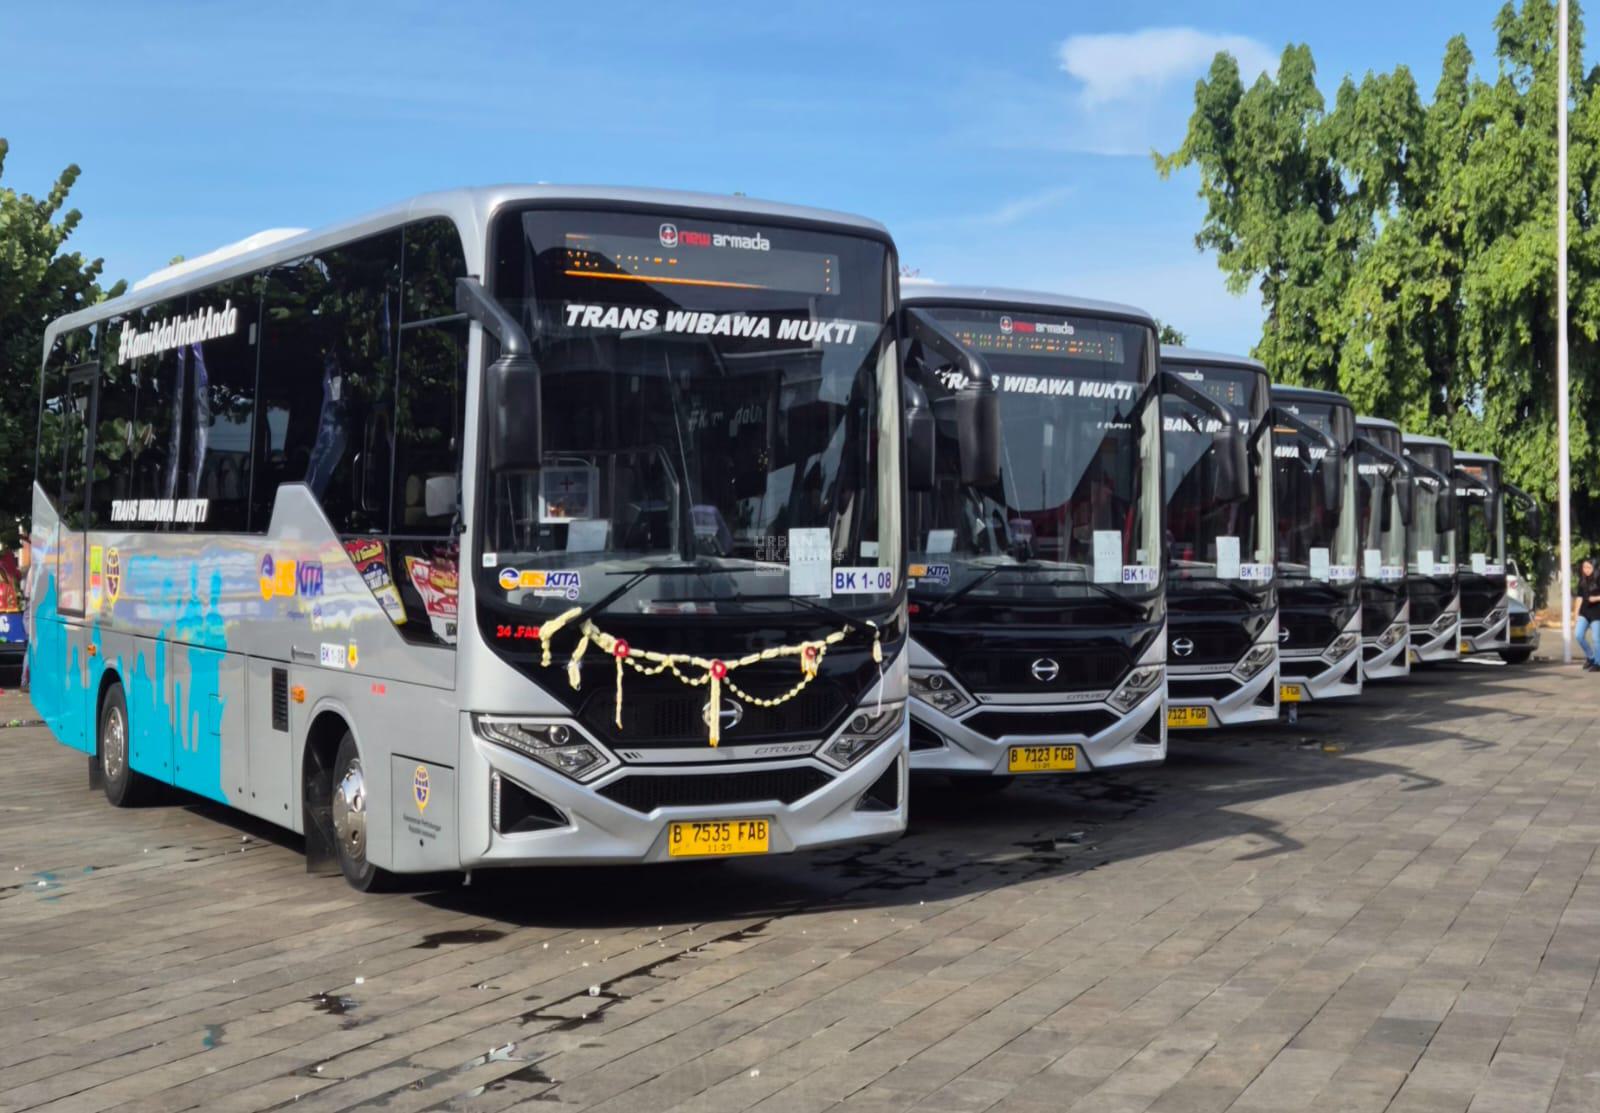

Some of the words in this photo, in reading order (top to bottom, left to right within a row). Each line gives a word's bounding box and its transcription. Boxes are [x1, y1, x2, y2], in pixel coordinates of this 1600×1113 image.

[713, 232, 770, 251] armada
[565, 304, 658, 330] TRANS
[664, 310, 770, 338] WIBAWA
[777, 319, 858, 345] MUKTI
[1003, 375, 1074, 397] WIBAWA
[1078, 381, 1134, 401] MUKTI
[111, 500, 138, 521] TRANS
[138, 499, 174, 522] WIBAWA
[174, 499, 209, 522] MUKTI
[835, 572, 856, 589] BK
[1124, 568, 1137, 581] BK
[1011, 749, 1018, 763] B
[1024, 748, 1050, 762] 7123
[1054, 747, 1074, 761] FGB
[673, 824, 682, 844] B
[692, 823, 731, 843] 7535
[738, 821, 767, 841] FAB
